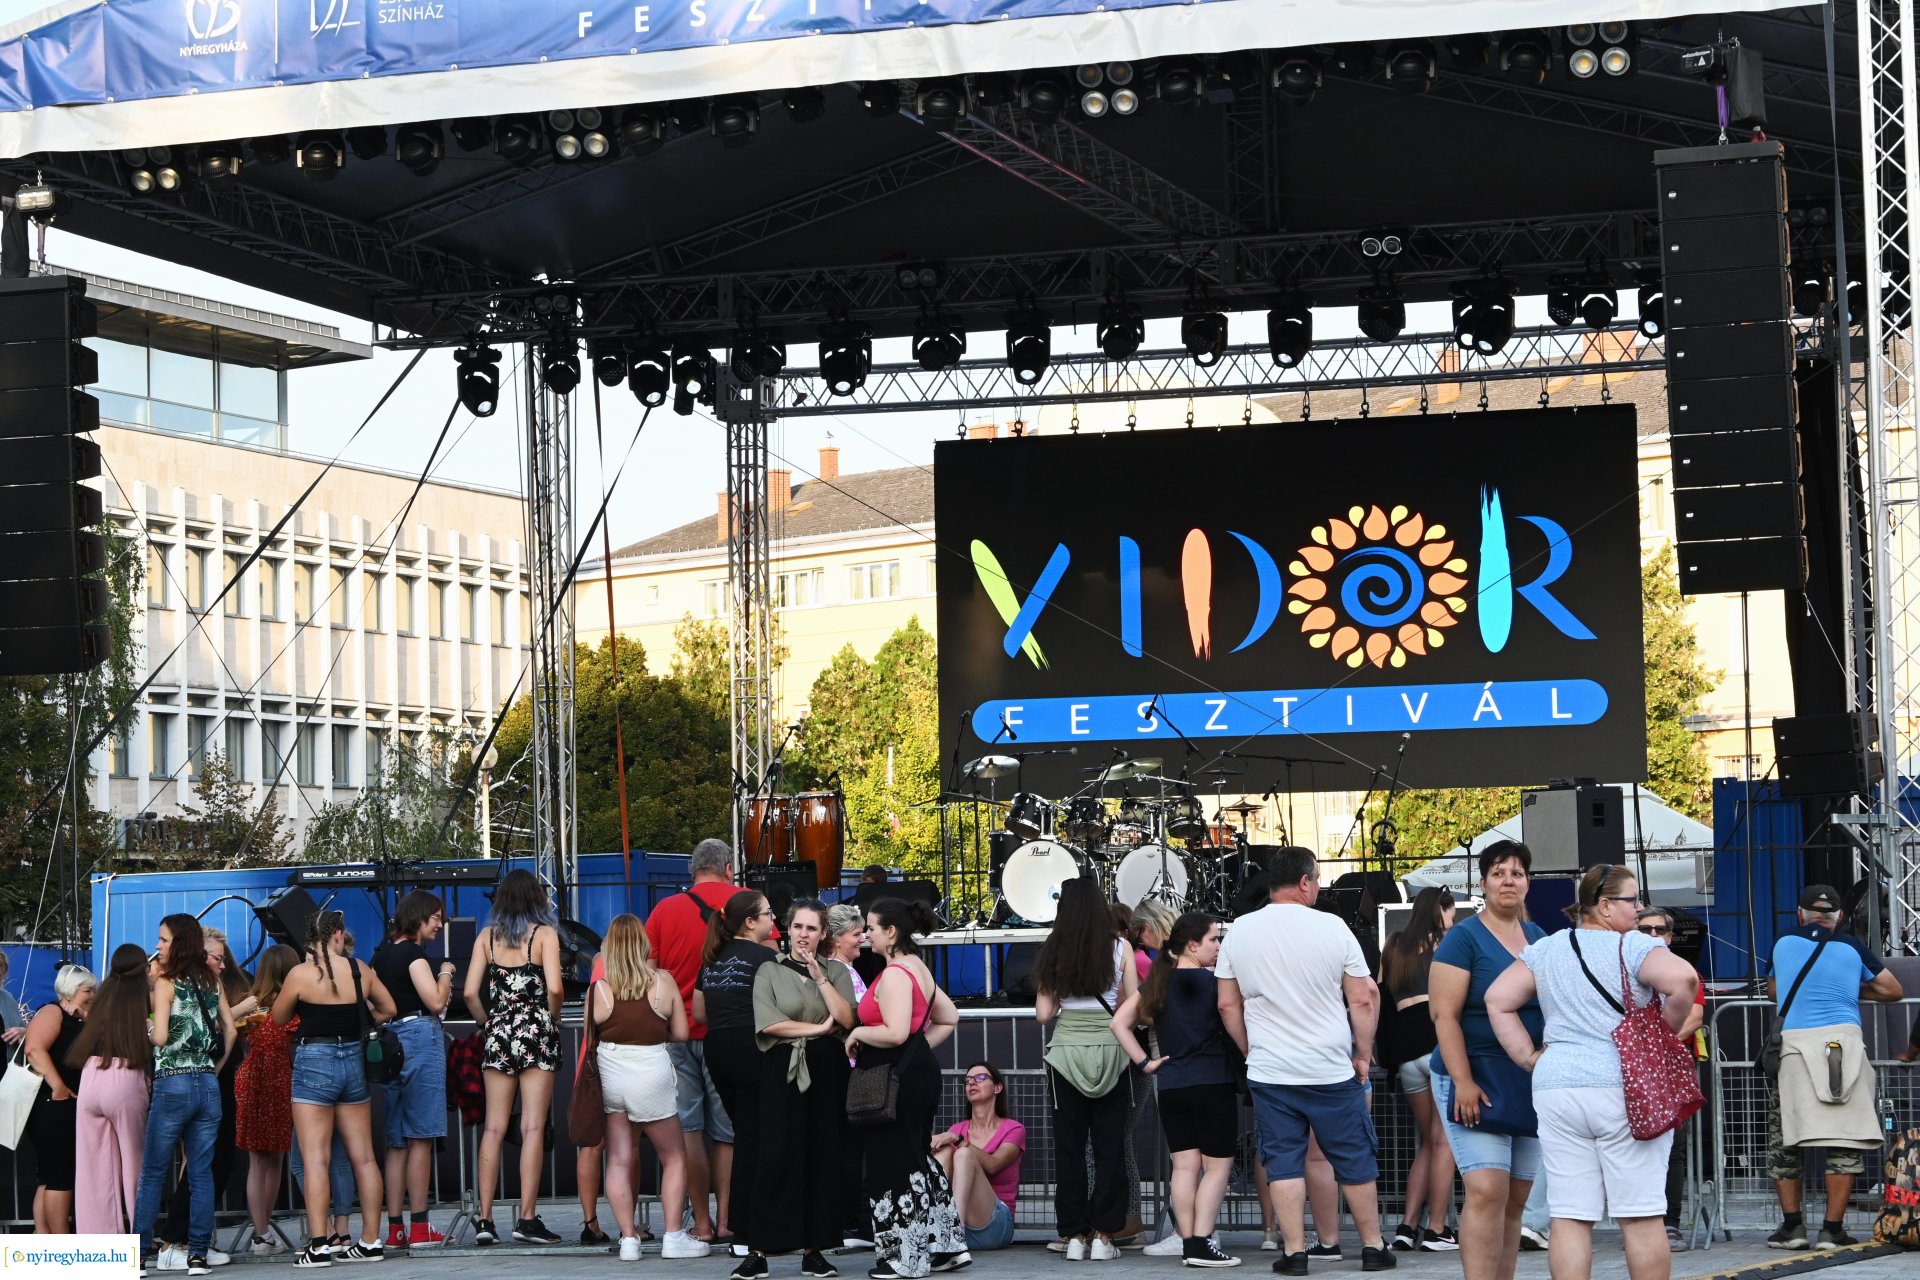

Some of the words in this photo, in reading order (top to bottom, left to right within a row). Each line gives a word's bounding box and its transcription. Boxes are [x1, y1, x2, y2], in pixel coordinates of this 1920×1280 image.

[378, 2, 444, 24] SZÍNHÁZ
[179, 40, 248, 57] NYÍREGYHÁZA
[970, 484, 1598, 670] VIDOR
[1005, 681, 1573, 737] FESZTIVÁL
[1028, 846, 1051, 857] Pearl
